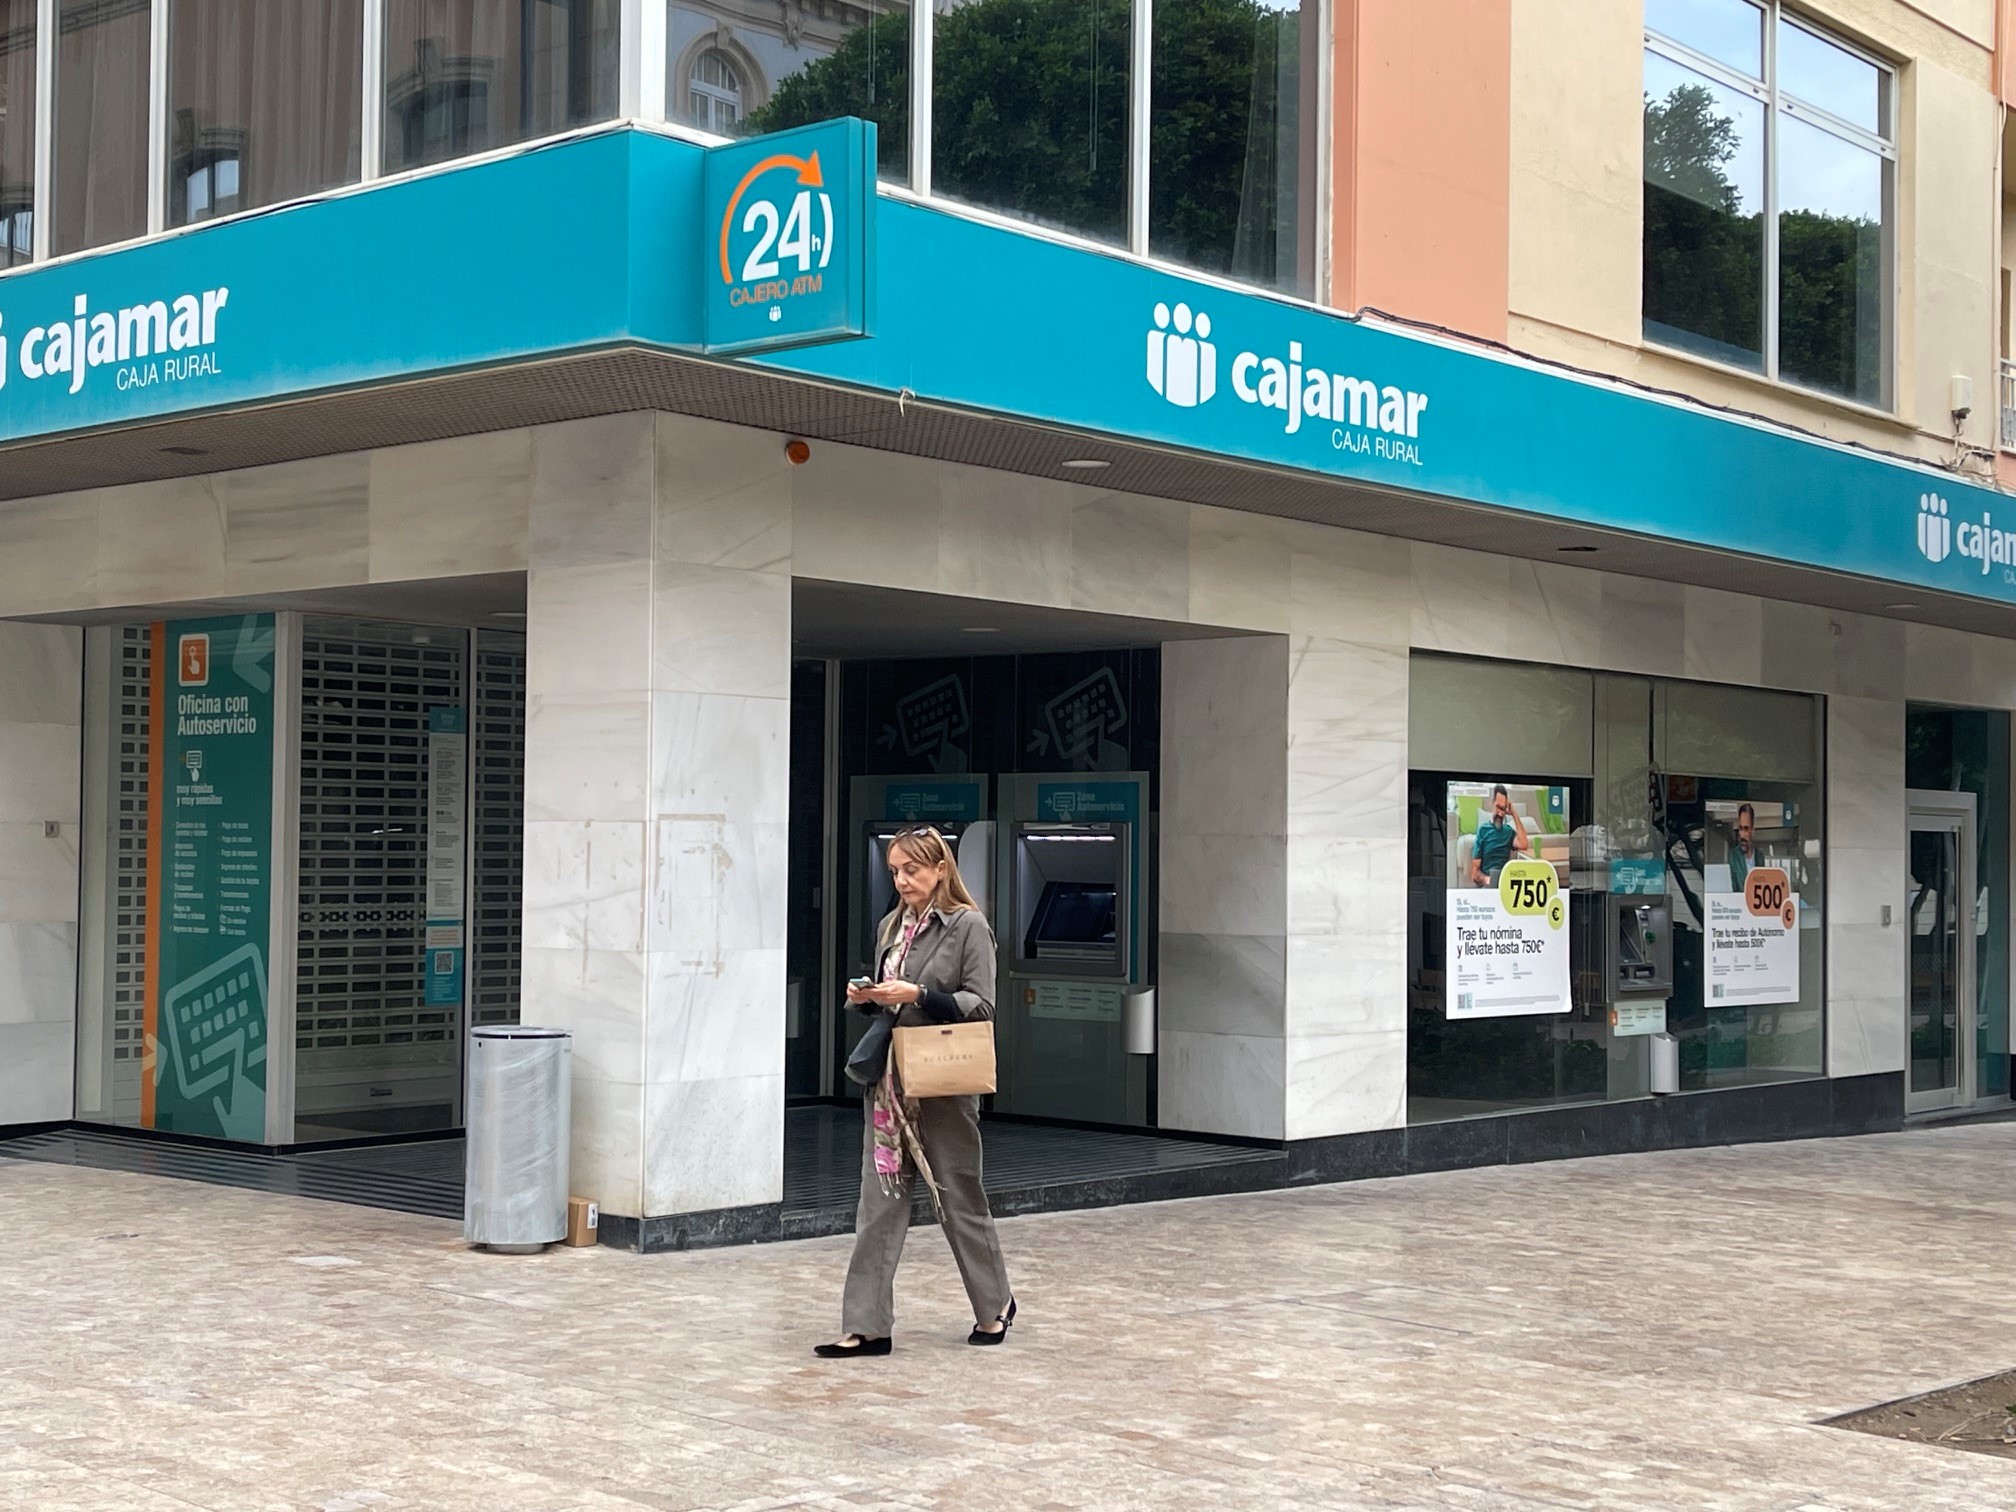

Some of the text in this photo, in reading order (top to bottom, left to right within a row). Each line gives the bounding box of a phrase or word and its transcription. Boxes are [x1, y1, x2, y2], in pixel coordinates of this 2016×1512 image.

[730, 273, 823, 307] CAJERO ATM
[20, 287, 229, 394] cajamar
[116, 352, 222, 391] CAJA RURAL
[1231, 341, 1428, 439] cajamar
[1331, 428, 1424, 466] CAJA RURAL
[178, 694, 249, 714] Oficina con
[177, 713, 257, 736] Autoservicio
[1552, 907, 1560, 921] €
[1457, 926, 1522, 941] Trae tu nómina
[1712, 928, 1723, 937] Trae
[1725, 928, 1731, 937] tu
[1750, 927, 1757, 937] de
[1457, 944, 1463, 959] y
[1465, 941, 1493, 956] llévate
[1495, 941, 1519, 954] hasta
[1735, 939, 1749, 948] hasta
